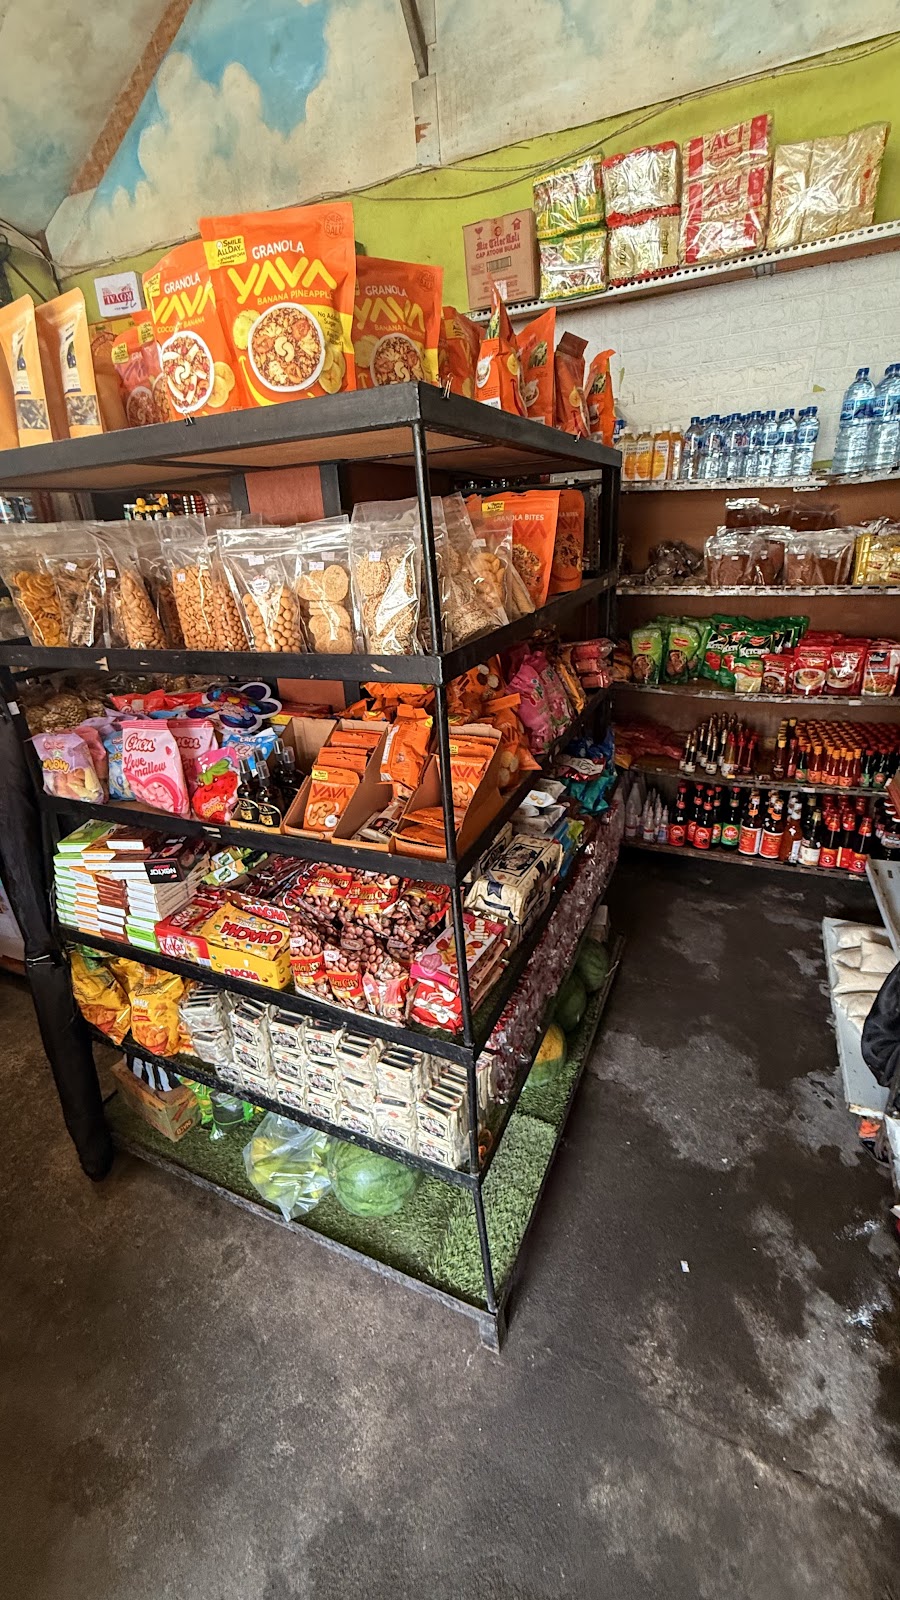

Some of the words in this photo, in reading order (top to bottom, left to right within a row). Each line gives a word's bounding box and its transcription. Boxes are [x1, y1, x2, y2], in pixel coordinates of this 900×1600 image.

[252, 240, 304, 260] GRANOLA
[164, 272, 201, 294] GRANOLA
[227, 256, 337, 305] YAVA
[104, 292, 133, 304] ROYAL
[257, 290, 288, 306] BANANA
[365, 285, 408, 298] GRANOLA
[183, 317, 205, 329] BANANA
[525, 513, 545, 521] BITES
[124, 732, 156, 752] Cucu
[123, 753, 146, 772] Love
[134, 761, 167, 777] mallow
[313, 784, 347, 799] YAVA
[219, 921, 283, 945] CHACHA
[161, 938, 185, 957] KitKat
